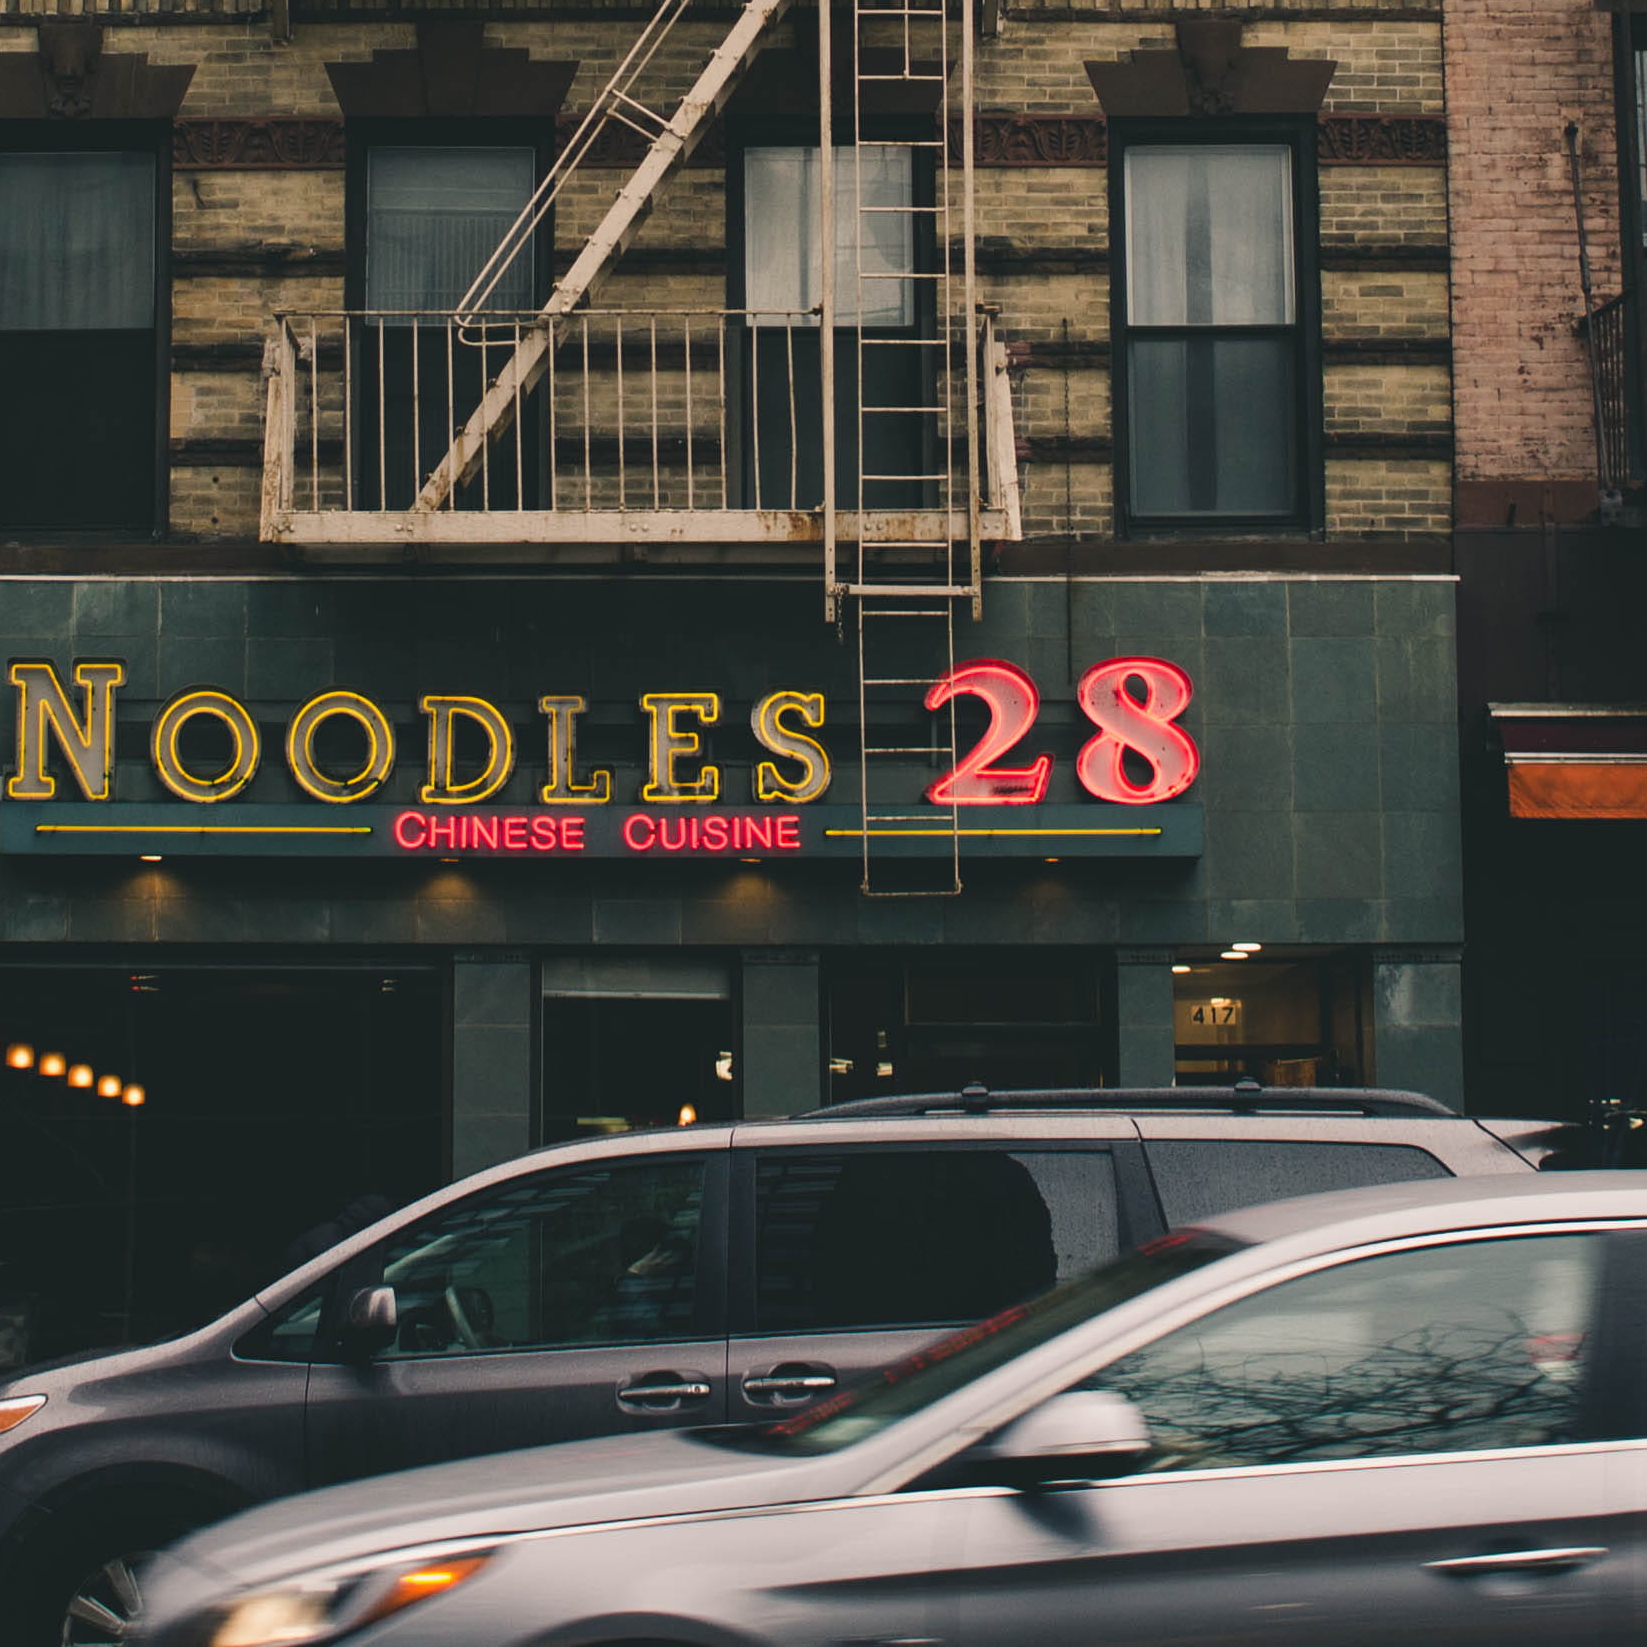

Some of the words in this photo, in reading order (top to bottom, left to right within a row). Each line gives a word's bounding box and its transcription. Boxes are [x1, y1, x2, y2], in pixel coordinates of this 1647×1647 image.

[6, 659, 831, 804] NOODLES
[924, 656, 1200, 805] 28
[394, 810, 585, 851] CHINESE
[622, 812, 802, 851] CUISINE
[1192, 1006, 1234, 1025] 417
